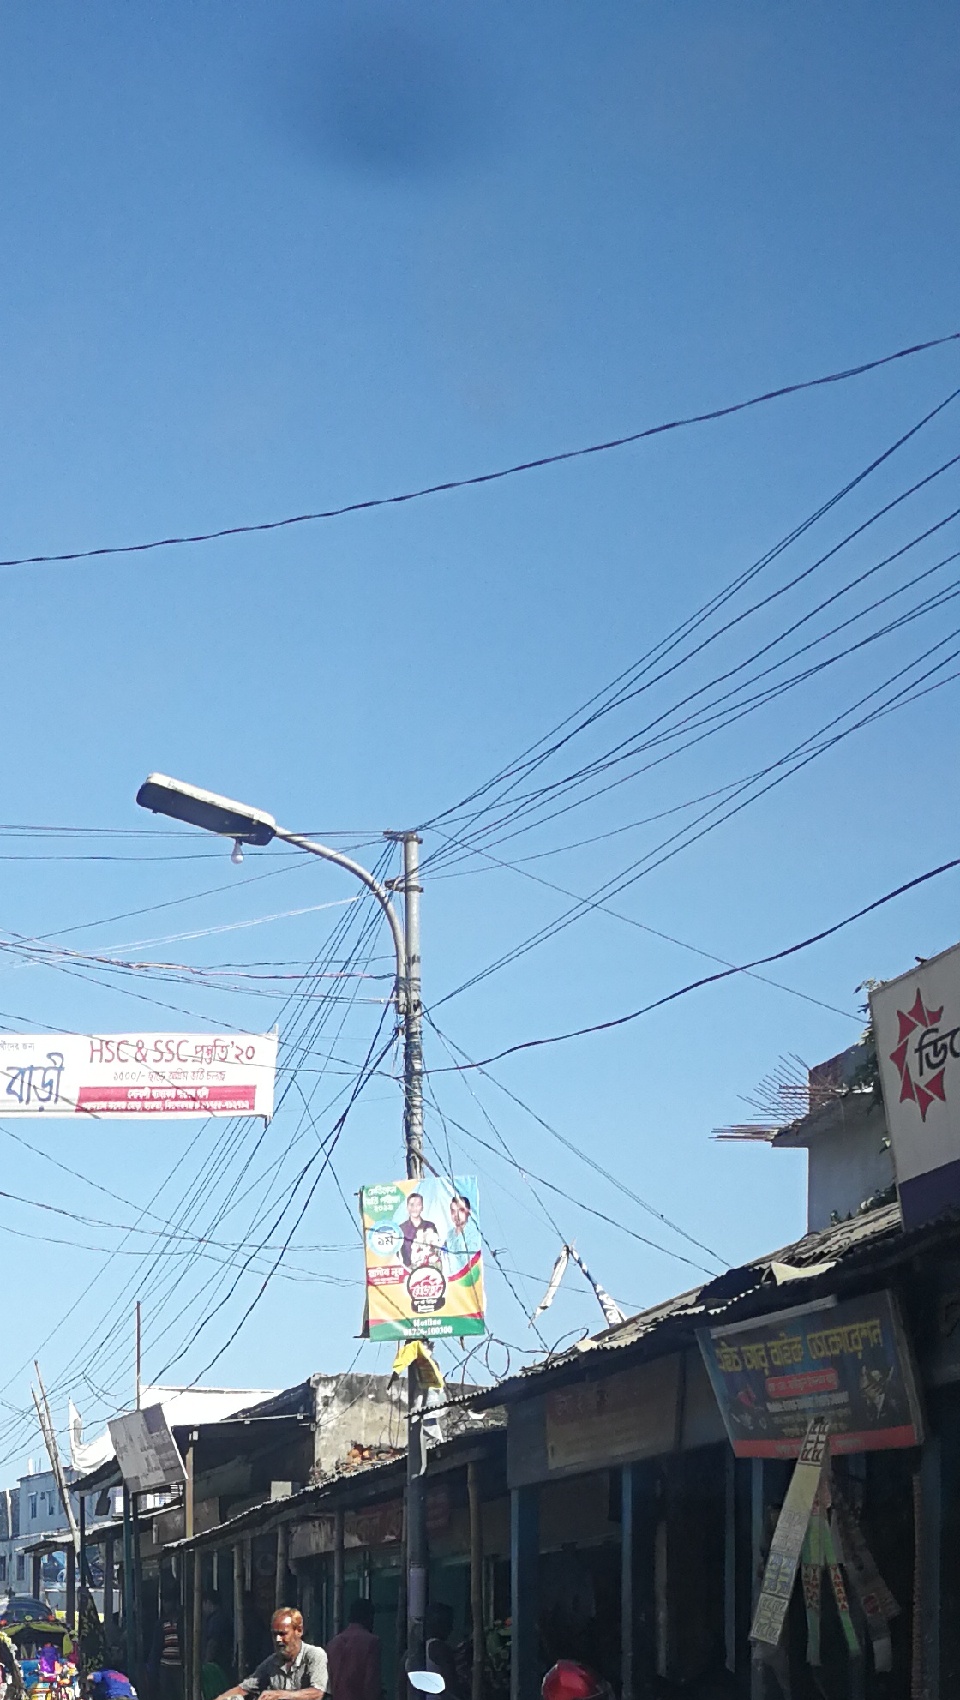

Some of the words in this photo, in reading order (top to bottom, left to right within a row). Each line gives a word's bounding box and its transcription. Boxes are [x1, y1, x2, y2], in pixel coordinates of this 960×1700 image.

[89, 1040, 129, 1063] HSC
[135, 1039, 148, 1063] &
[152, 1039, 189, 1063] SSC
[6, 1052, 65, 1112] বাড়ী
